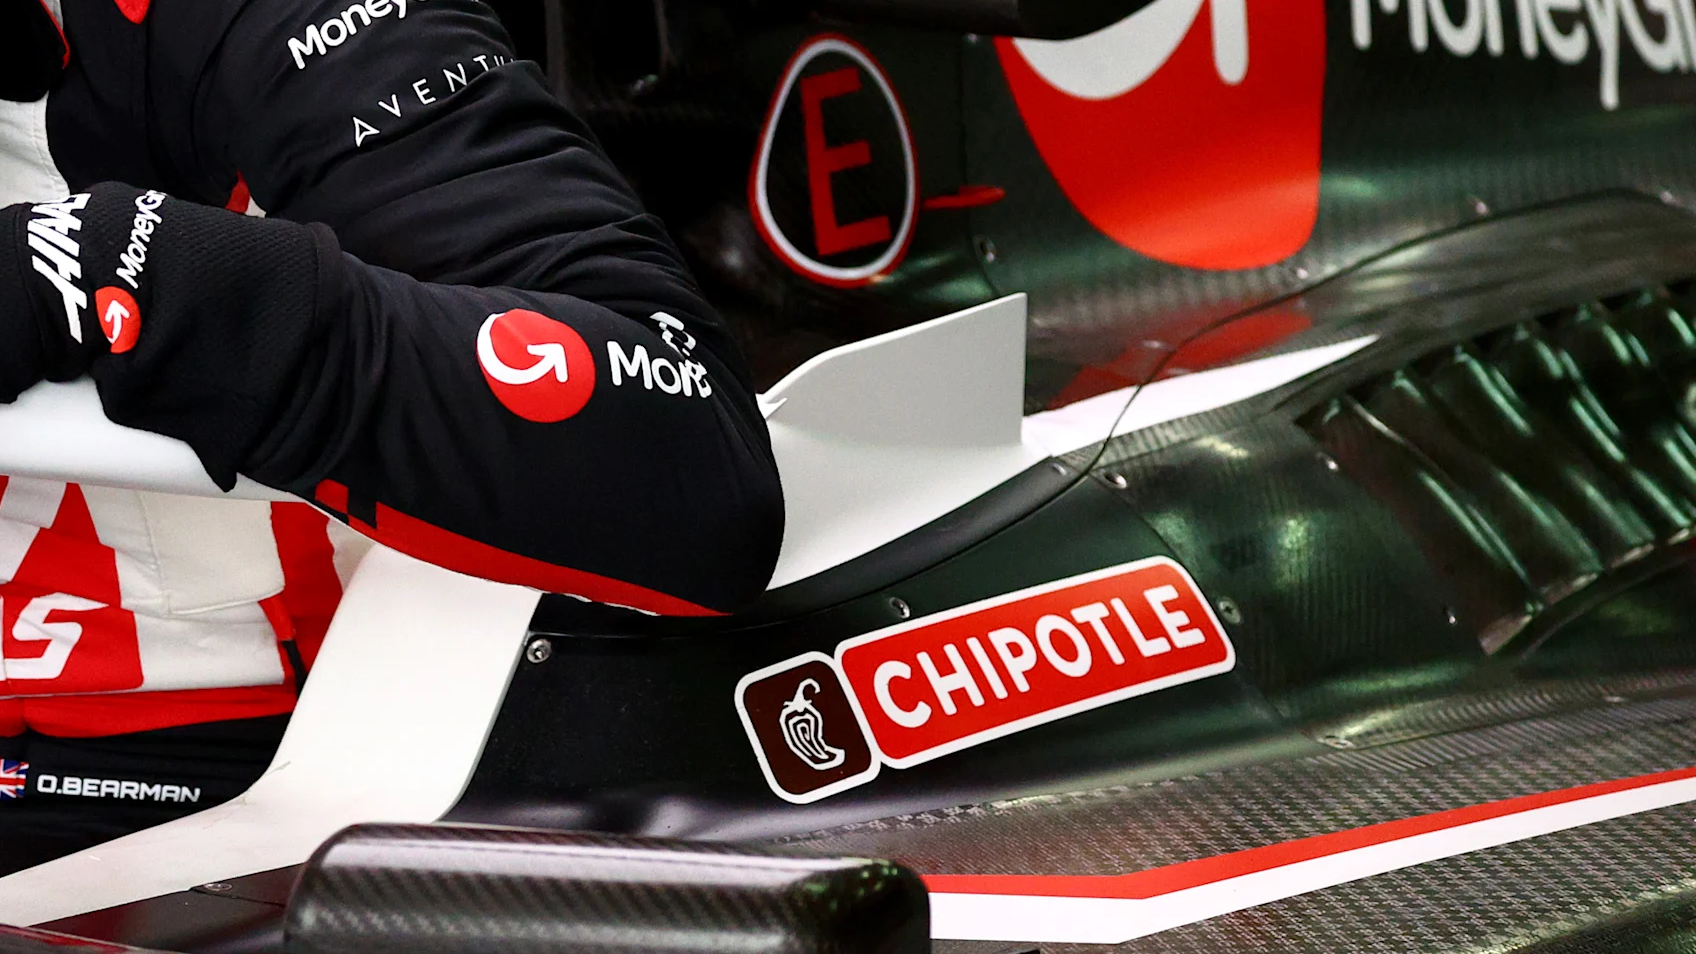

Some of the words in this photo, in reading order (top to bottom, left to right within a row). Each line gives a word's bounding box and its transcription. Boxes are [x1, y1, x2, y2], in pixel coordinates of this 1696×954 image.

[800, 67, 892, 256] E
[872, 583, 1207, 730] CHIPOTLE
[36, 773, 202, 803] O.BEARMAN
